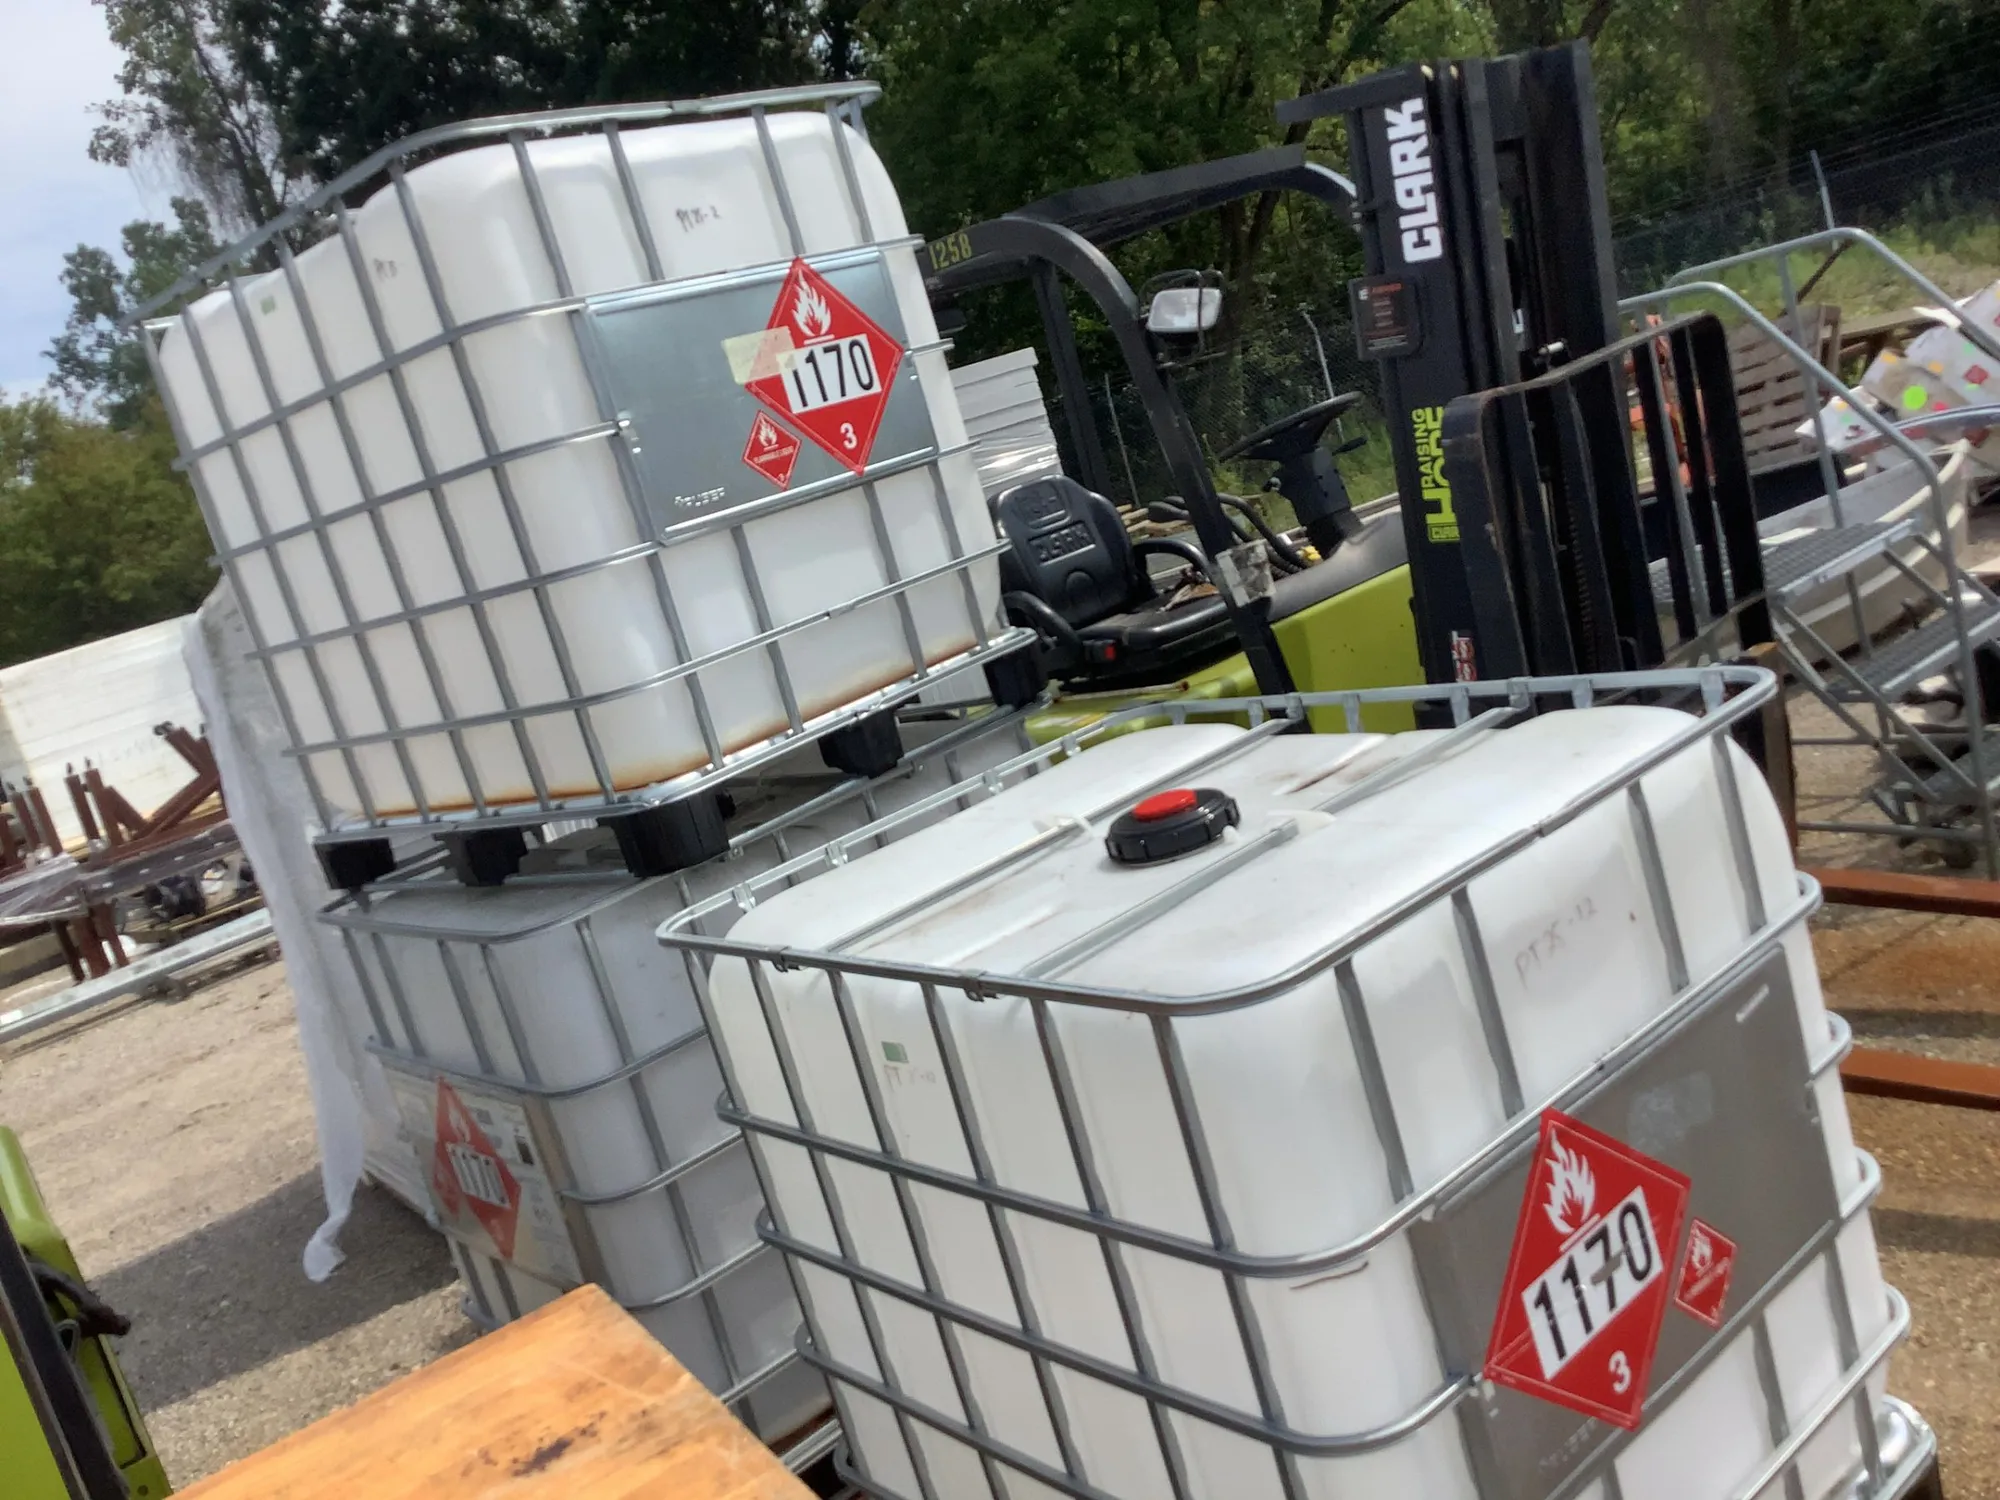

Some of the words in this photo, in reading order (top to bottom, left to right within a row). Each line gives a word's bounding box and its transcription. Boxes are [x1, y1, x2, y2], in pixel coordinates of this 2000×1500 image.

[1384, 97, 1443, 263] CLARK
[929, 232, 972, 270] 1258
[787, 338, 875, 408] 1170
[840, 421, 858, 450] 3
[1411, 408, 1435, 489] RAISING
[1534, 1201, 1653, 1361] 1170
[1608, 1350, 1633, 1396] 3
